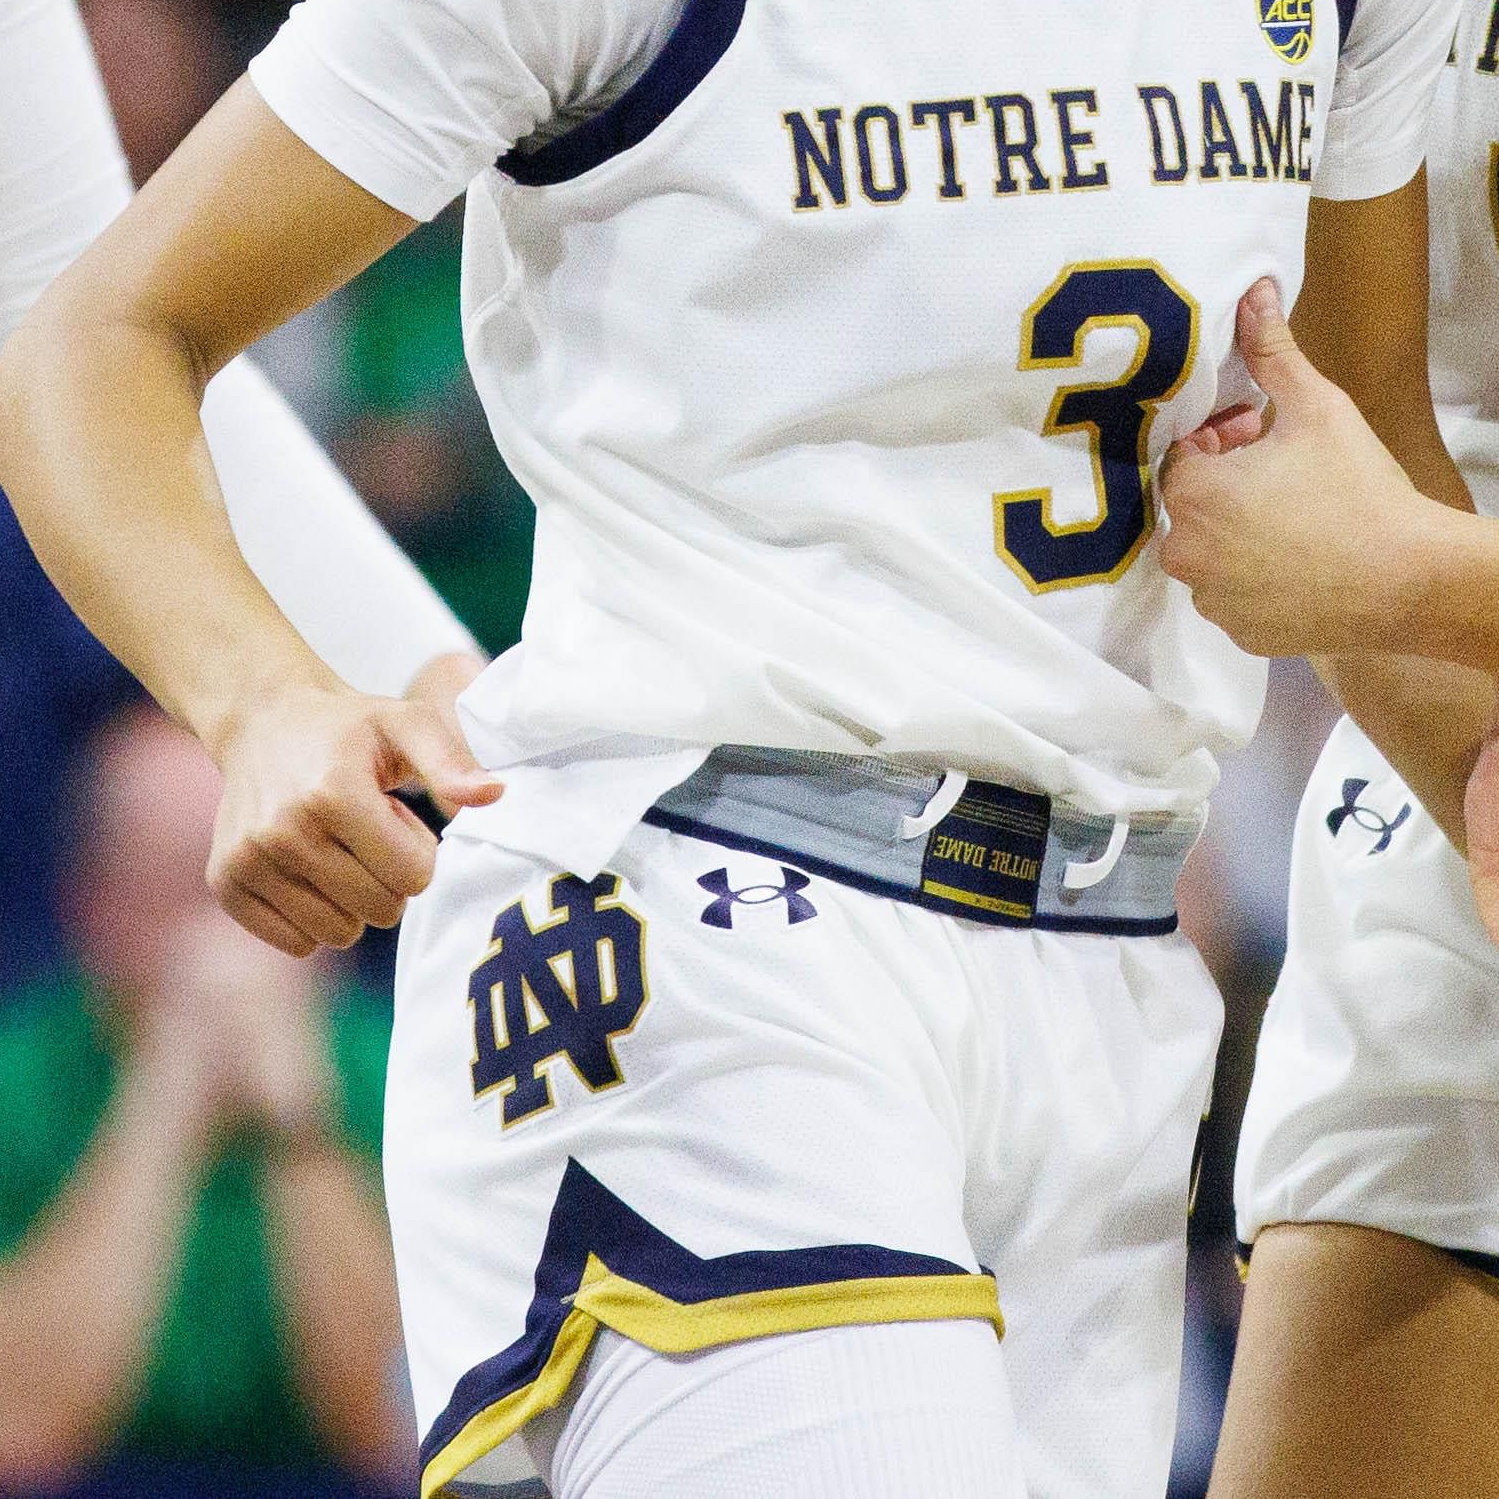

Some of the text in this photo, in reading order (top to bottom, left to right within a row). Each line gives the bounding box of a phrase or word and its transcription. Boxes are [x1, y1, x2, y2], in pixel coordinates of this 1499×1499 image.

[781, 79, 1315, 212] NOTRE DAME
[992, 258, 1201, 595] 3
[933, 835, 1039, 881] NOTRE DAME
[465, 868, 651, 1132] ND
